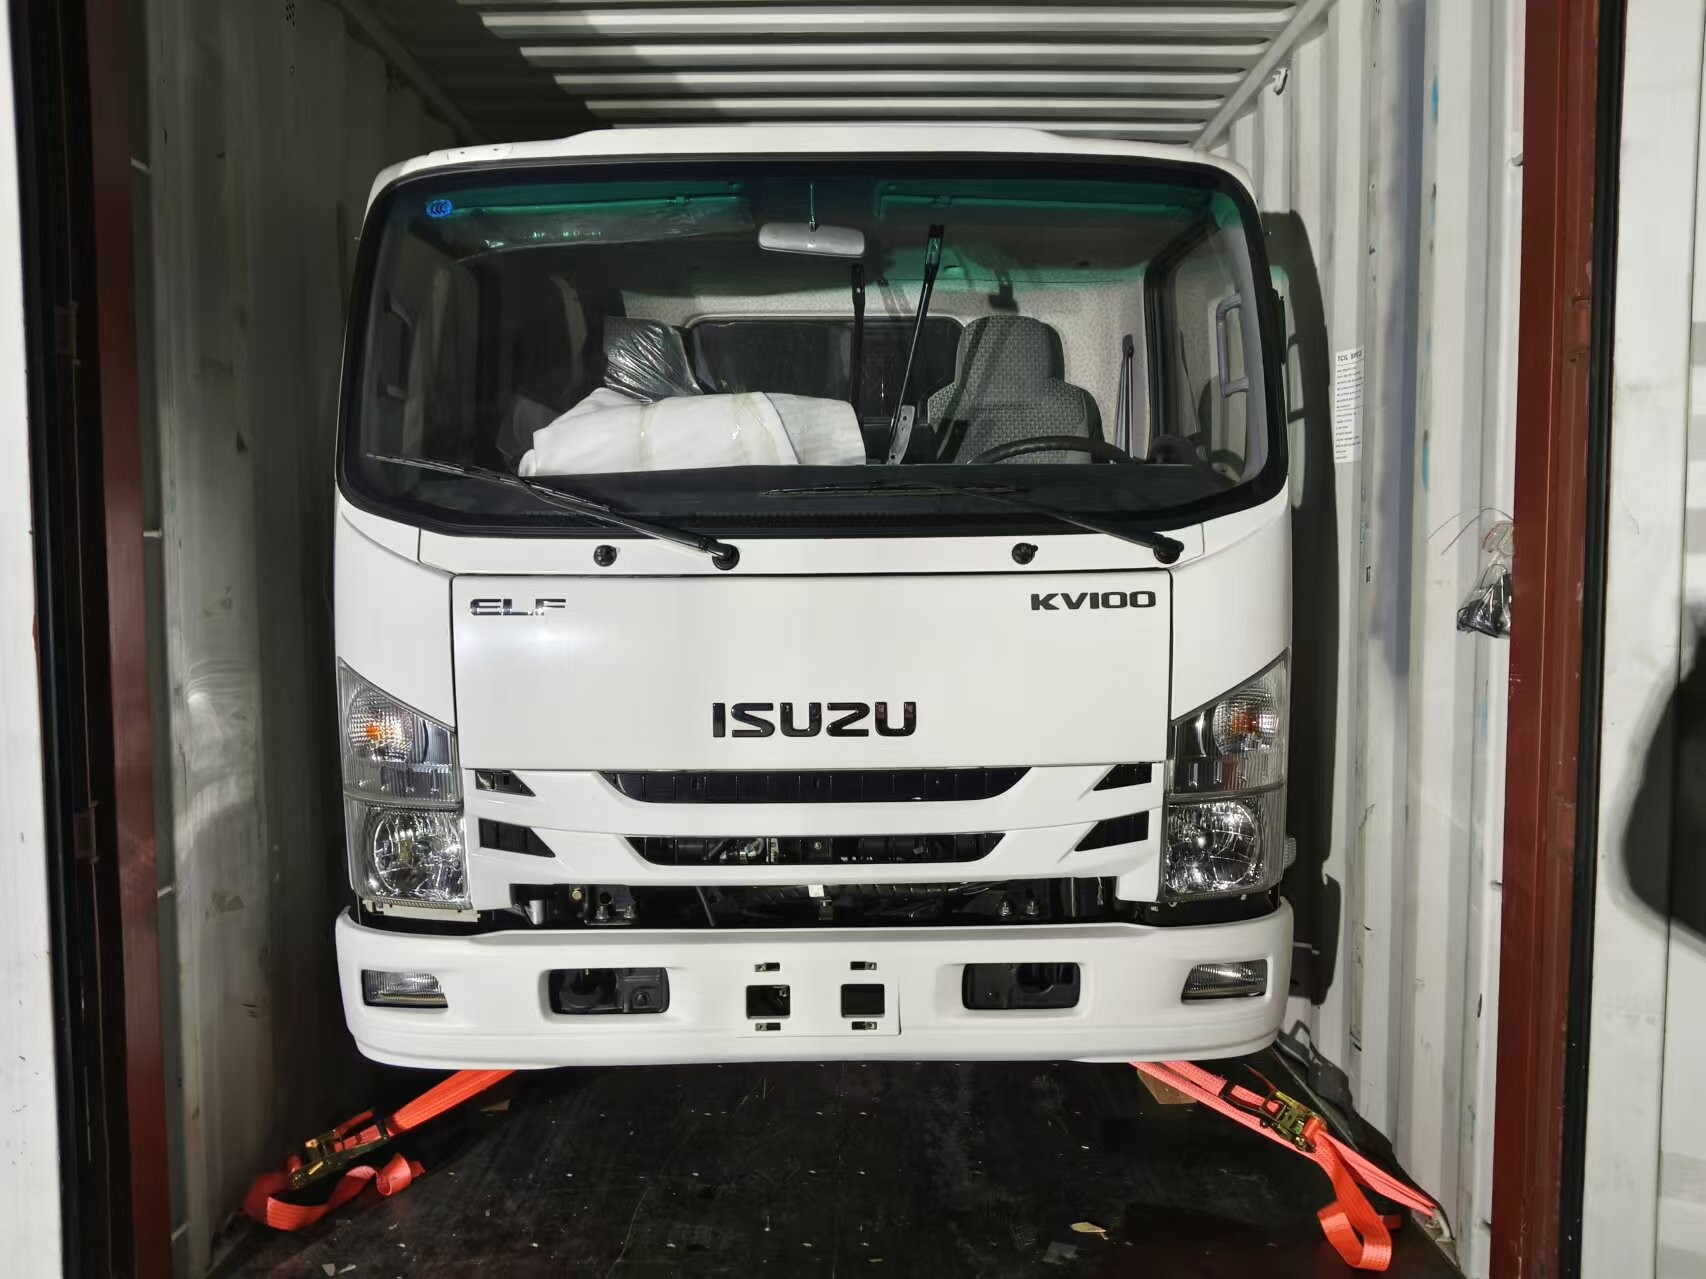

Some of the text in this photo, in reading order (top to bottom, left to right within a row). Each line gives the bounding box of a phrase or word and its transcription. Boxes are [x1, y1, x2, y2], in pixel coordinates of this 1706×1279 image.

[470, 598, 566, 616] ELF
[1030, 590, 1156, 611] KV100
[712, 701, 917, 738] ISUZU
